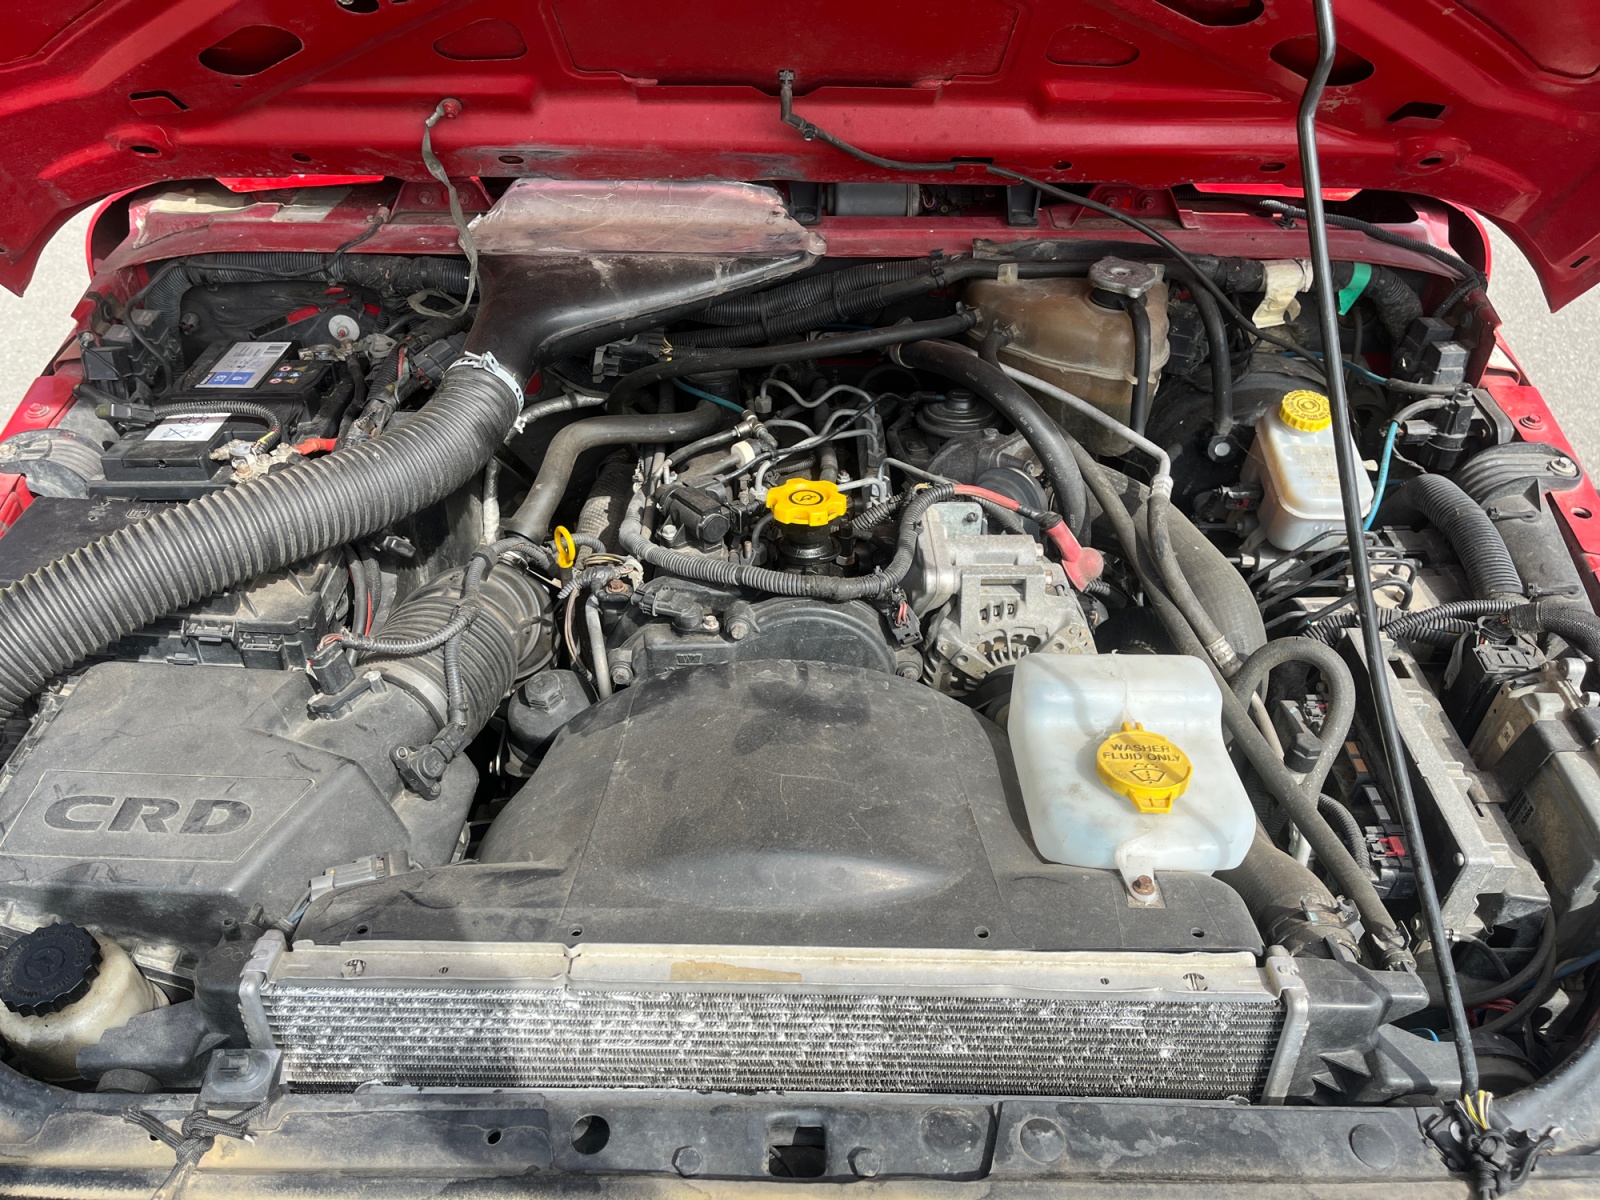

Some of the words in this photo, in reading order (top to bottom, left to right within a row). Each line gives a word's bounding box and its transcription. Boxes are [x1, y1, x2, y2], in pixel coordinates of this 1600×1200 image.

[1111, 744, 1170, 753] WASHER
[1102, 752, 1142, 760] FLUID
[1147, 753, 1181, 762] ONLY
[44, 795, 252, 835] CRD
